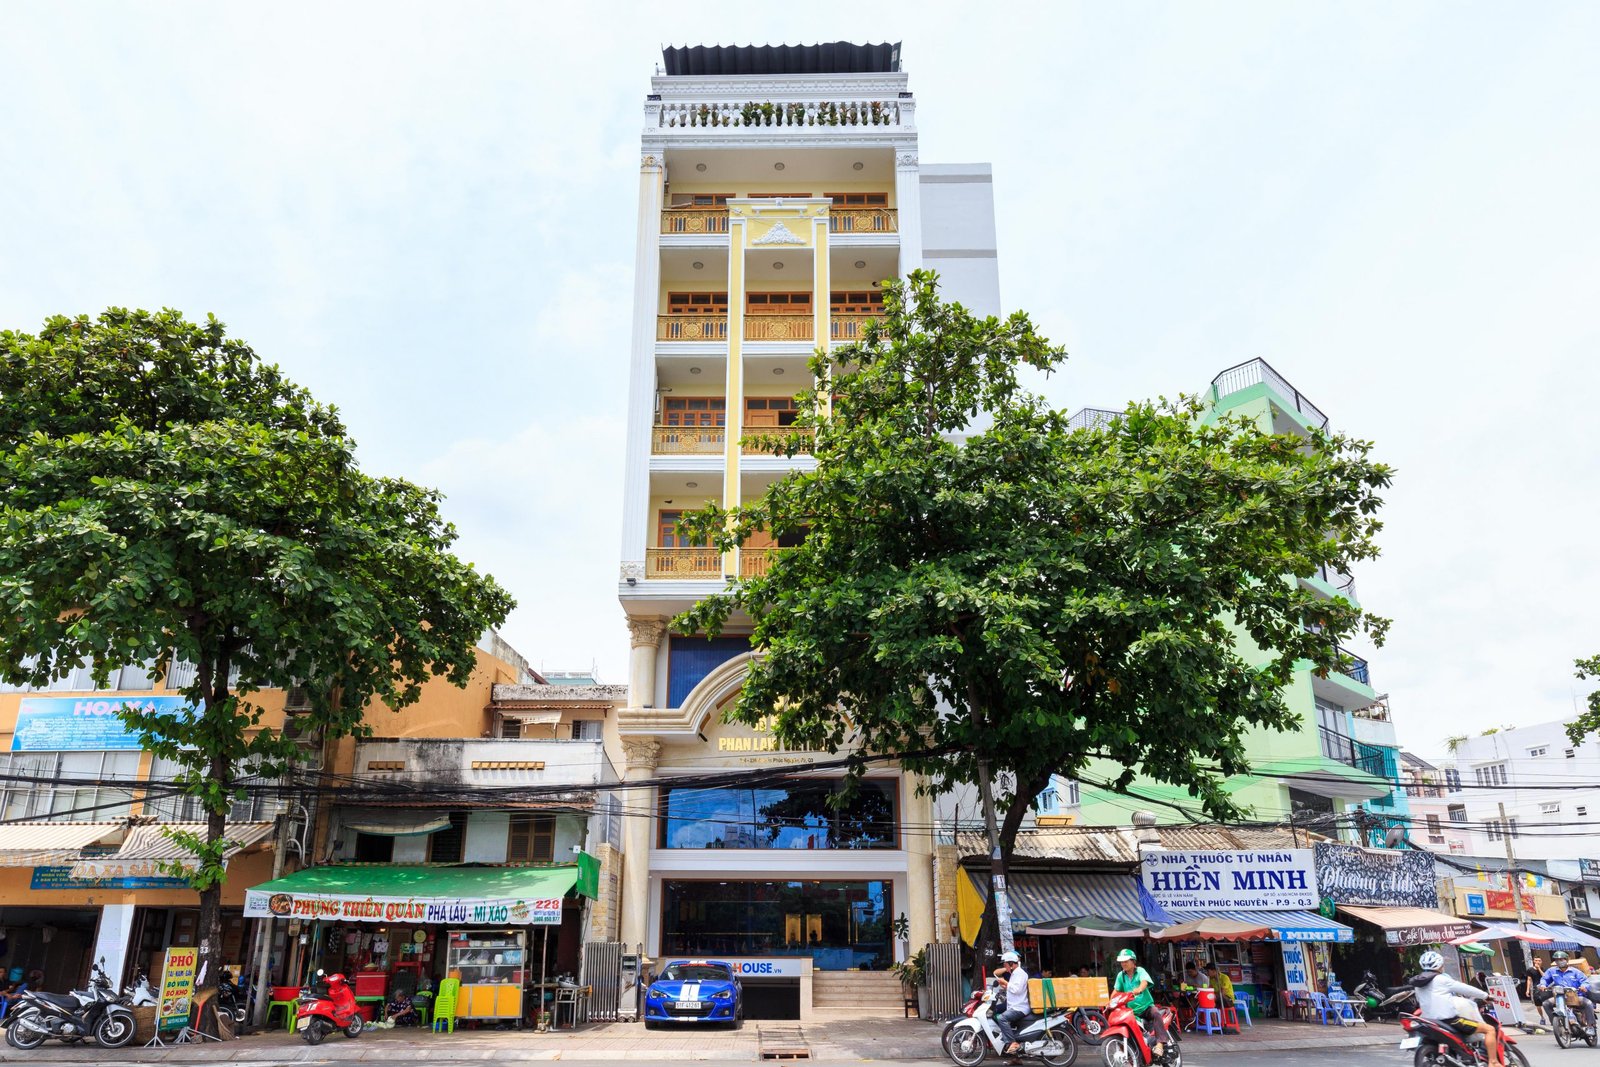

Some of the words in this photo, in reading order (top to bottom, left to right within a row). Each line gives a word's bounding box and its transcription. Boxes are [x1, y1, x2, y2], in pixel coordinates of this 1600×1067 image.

[718, 737, 752, 751] PHAN
[1161, 853, 1187, 864] NHÀ
[1191, 852, 1233, 864] THUỐC
[1237, 853, 1254, 863] TƯ
[1257, 853, 1293, 863] NHÂN
[1150, 864, 1221, 891] HIỀN
[1231, 870, 1309, 890] MINH
[293, 899, 339, 919] PHỤNG
[343, 896, 384, 917] THIÊN
[385, 898, 426, 921] QUÁN
[427, 901, 447, 921] PHÁ
[449, 897, 467, 921] LẤU
[473, 901, 486, 921] MÌ
[488, 902, 508, 921] XÀO
[1208, 897, 1232, 907] PHÚC
[1297, 898, 1312, 906] Q.3
[169, 951, 194, 967] PHỞ
